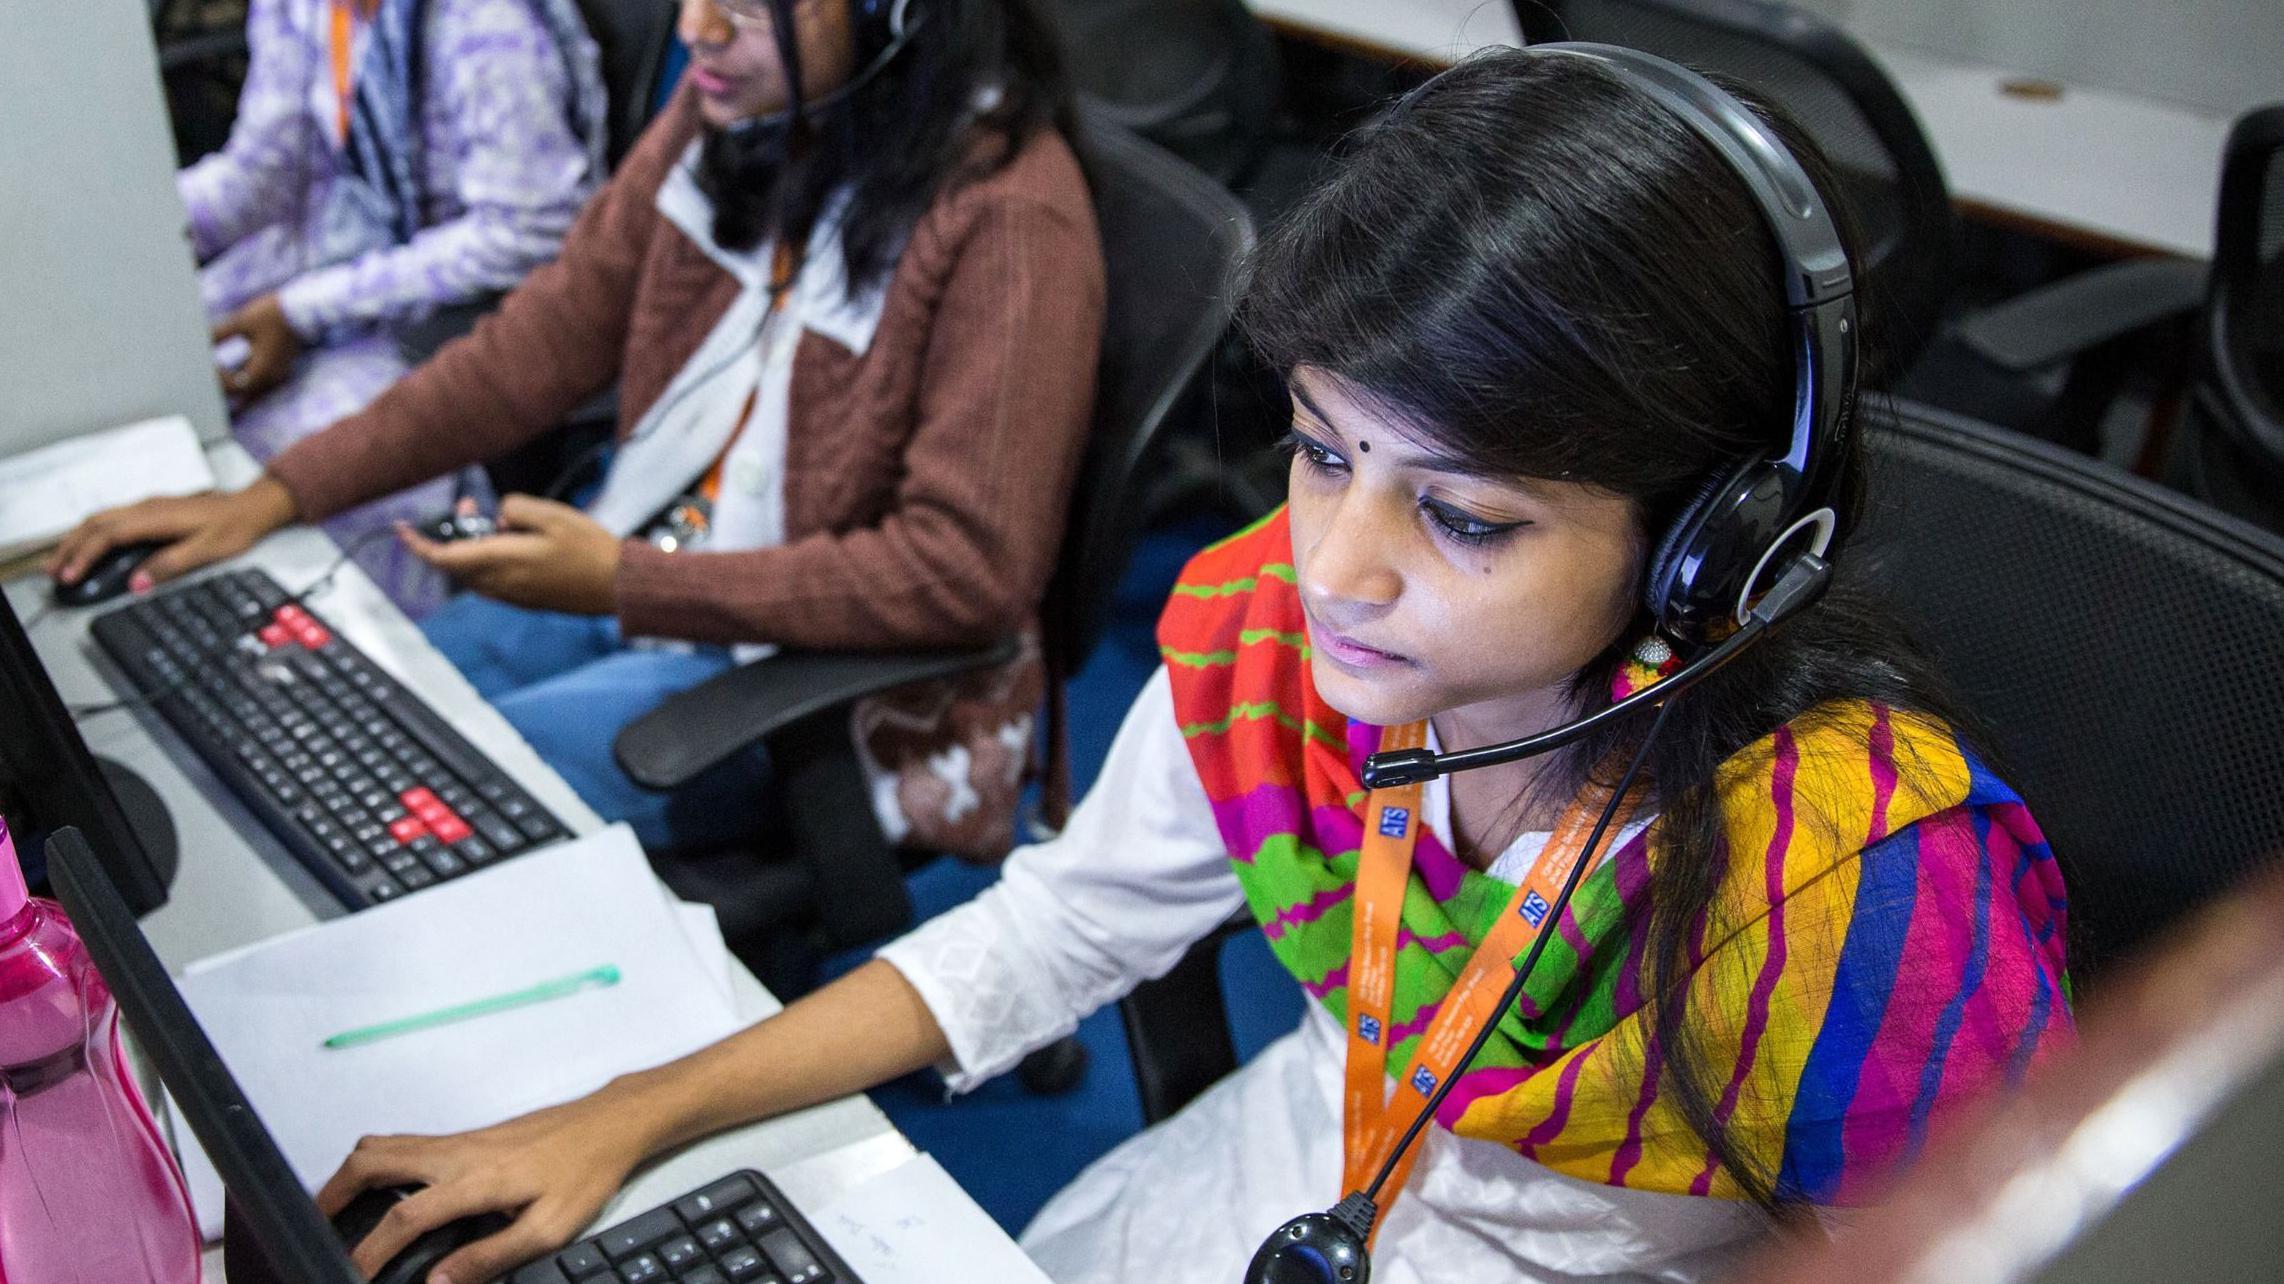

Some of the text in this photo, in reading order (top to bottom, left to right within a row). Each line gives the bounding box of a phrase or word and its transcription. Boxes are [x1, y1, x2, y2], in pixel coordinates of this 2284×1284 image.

[1381, 807, 1407, 838] ATS
[1519, 891, 1548, 927] ATS
[1413, 1065, 1436, 1096] ATS
